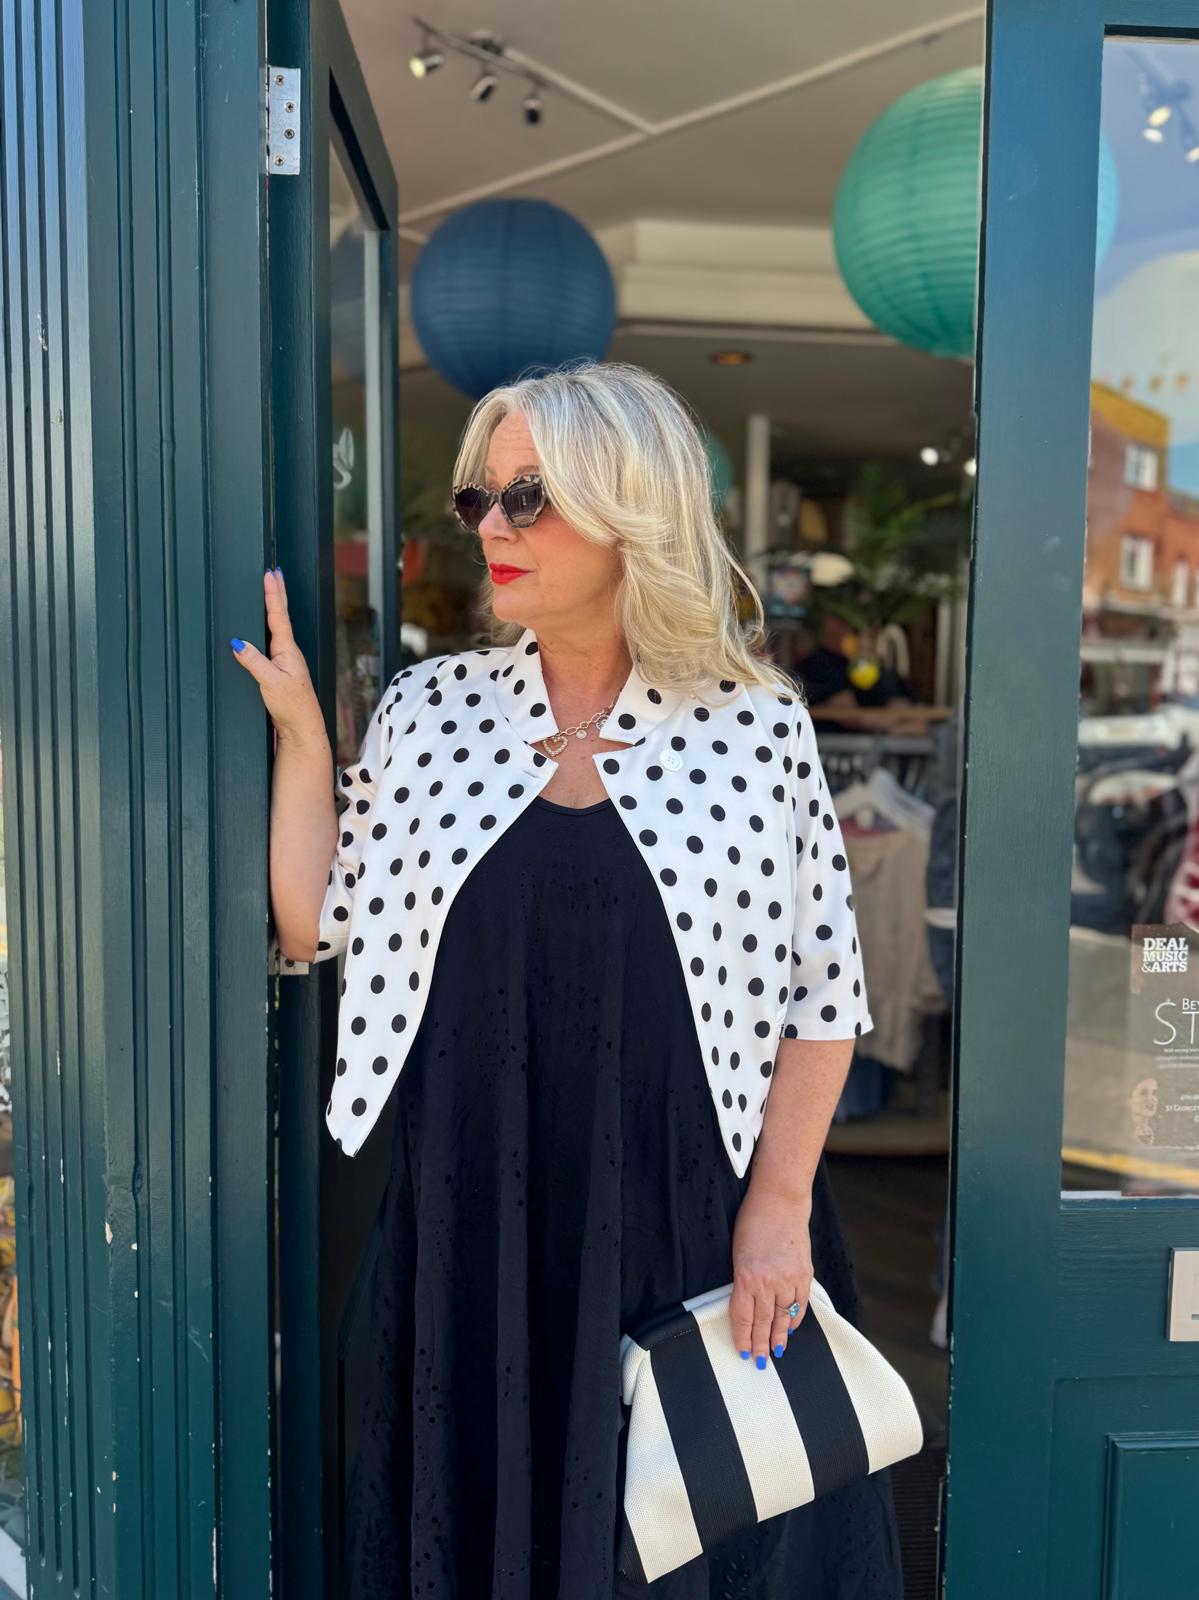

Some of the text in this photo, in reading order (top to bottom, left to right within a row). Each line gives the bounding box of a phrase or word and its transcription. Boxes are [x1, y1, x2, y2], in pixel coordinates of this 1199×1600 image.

[1143, 937, 1189, 950] DEAL
[1143, 950, 1188, 962] MUSIC
[1141, 961, 1188, 973] &ARTS
